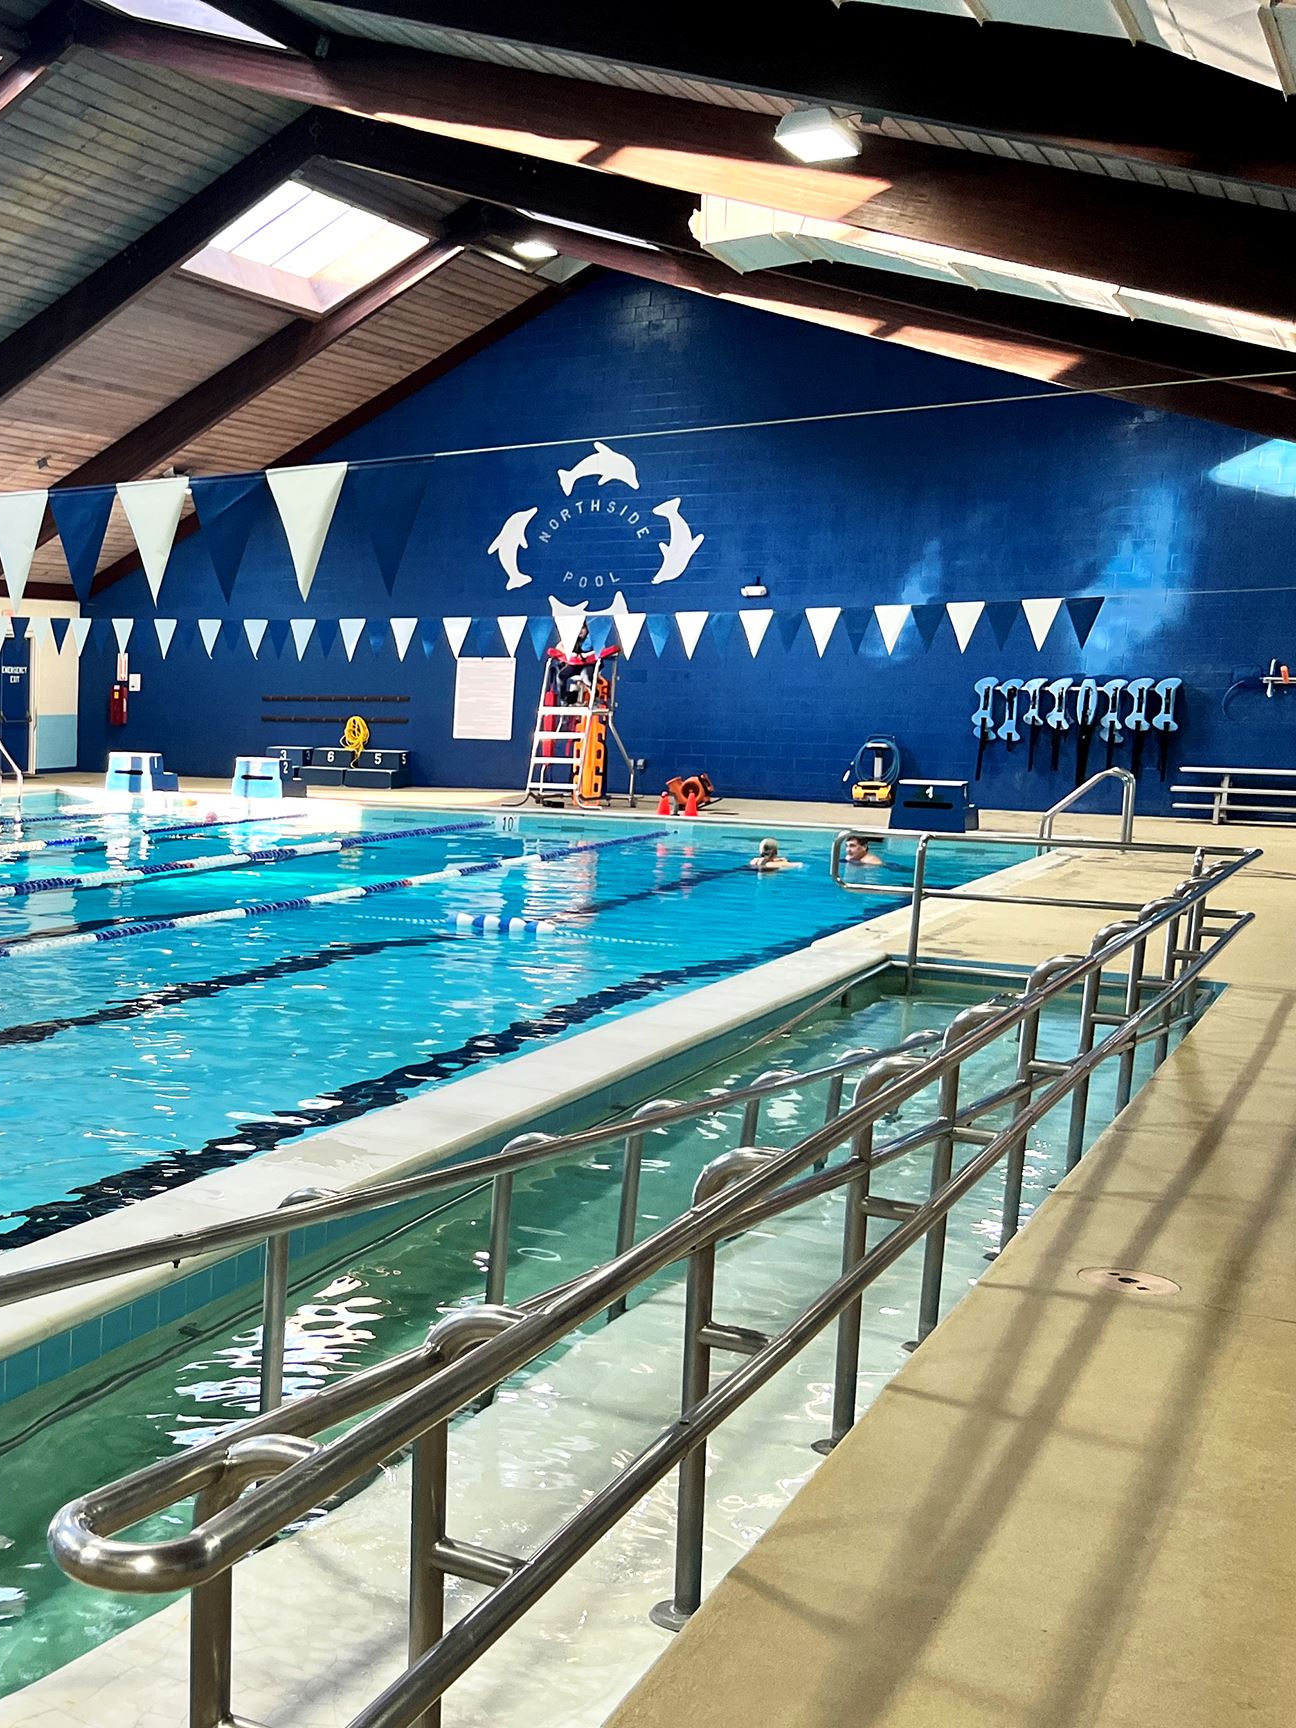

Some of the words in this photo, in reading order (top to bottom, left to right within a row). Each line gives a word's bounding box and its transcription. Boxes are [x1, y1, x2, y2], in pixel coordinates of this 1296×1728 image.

[538, 499, 650, 544] NORTHSIDE
[562, 571, 621, 588] POOL
[280, 750, 287, 760] 3
[327, 751, 334, 762] 6
[374, 753, 382, 764] 5
[402, 753, 406, 764] 5
[283, 761, 288, 774] 2
[503, 816, 514, 831] 10
